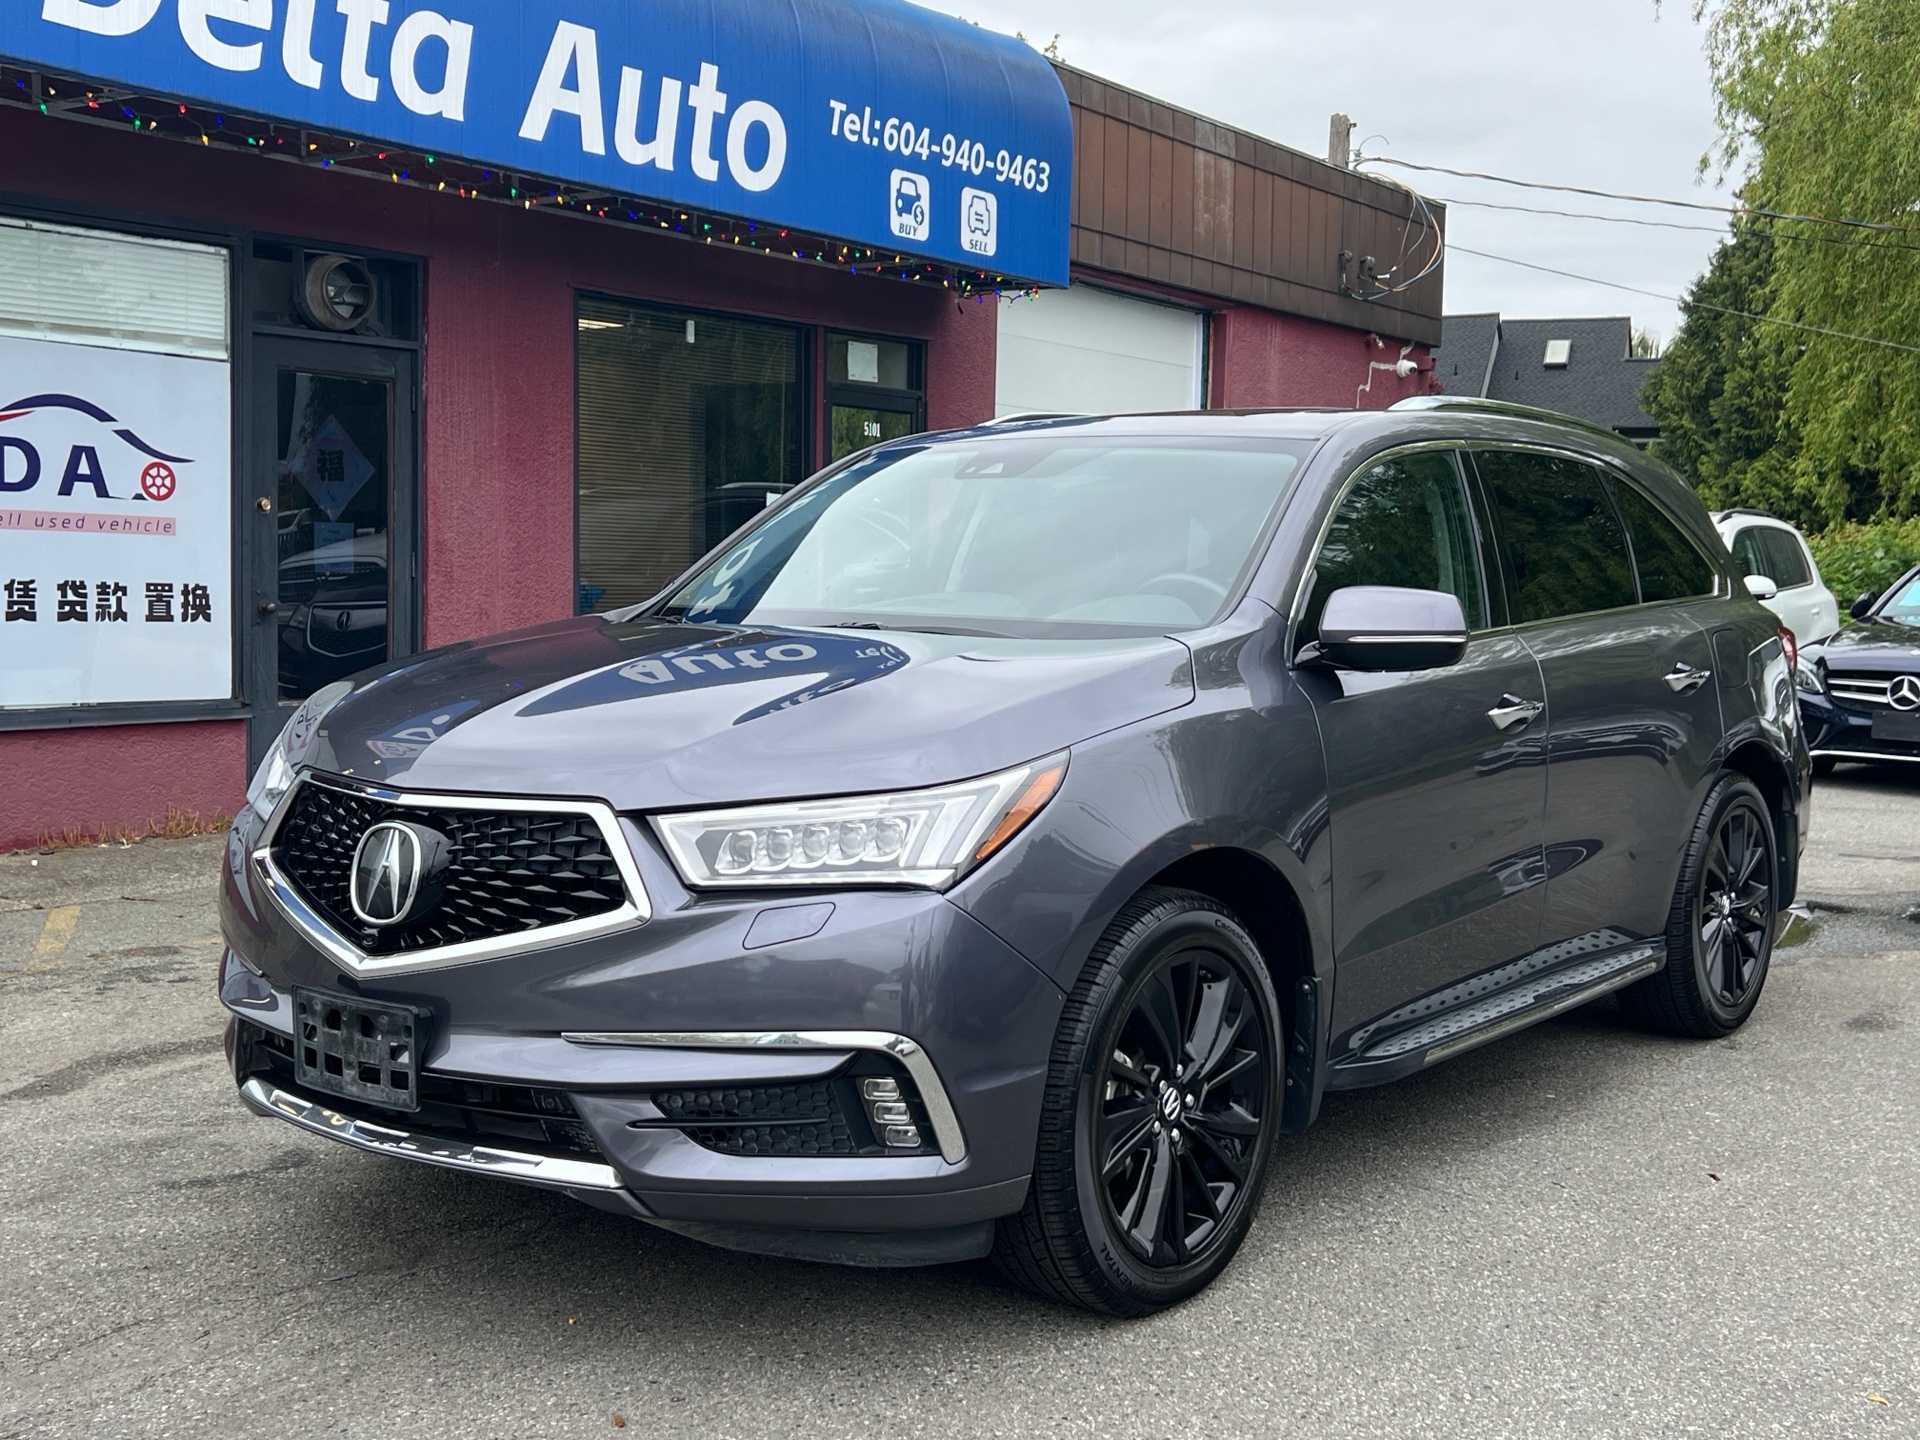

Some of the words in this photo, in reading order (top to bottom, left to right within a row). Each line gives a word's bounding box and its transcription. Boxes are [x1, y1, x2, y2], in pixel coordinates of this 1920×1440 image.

[41, 0, 474, 122] elta
[518, 19, 787, 192] Auto
[898, 222, 919, 237] BUY
[968, 238, 989, 253] SELL
[863, 421, 881, 437] 5101
[316, 448, 346, 483] 福
[34, 515, 86, 530] used
[97, 518, 173, 534] vehicle
[4, 578, 37, 622] 赁
[56, 580, 128, 622] 贷款
[145, 582, 212, 623] 置换
